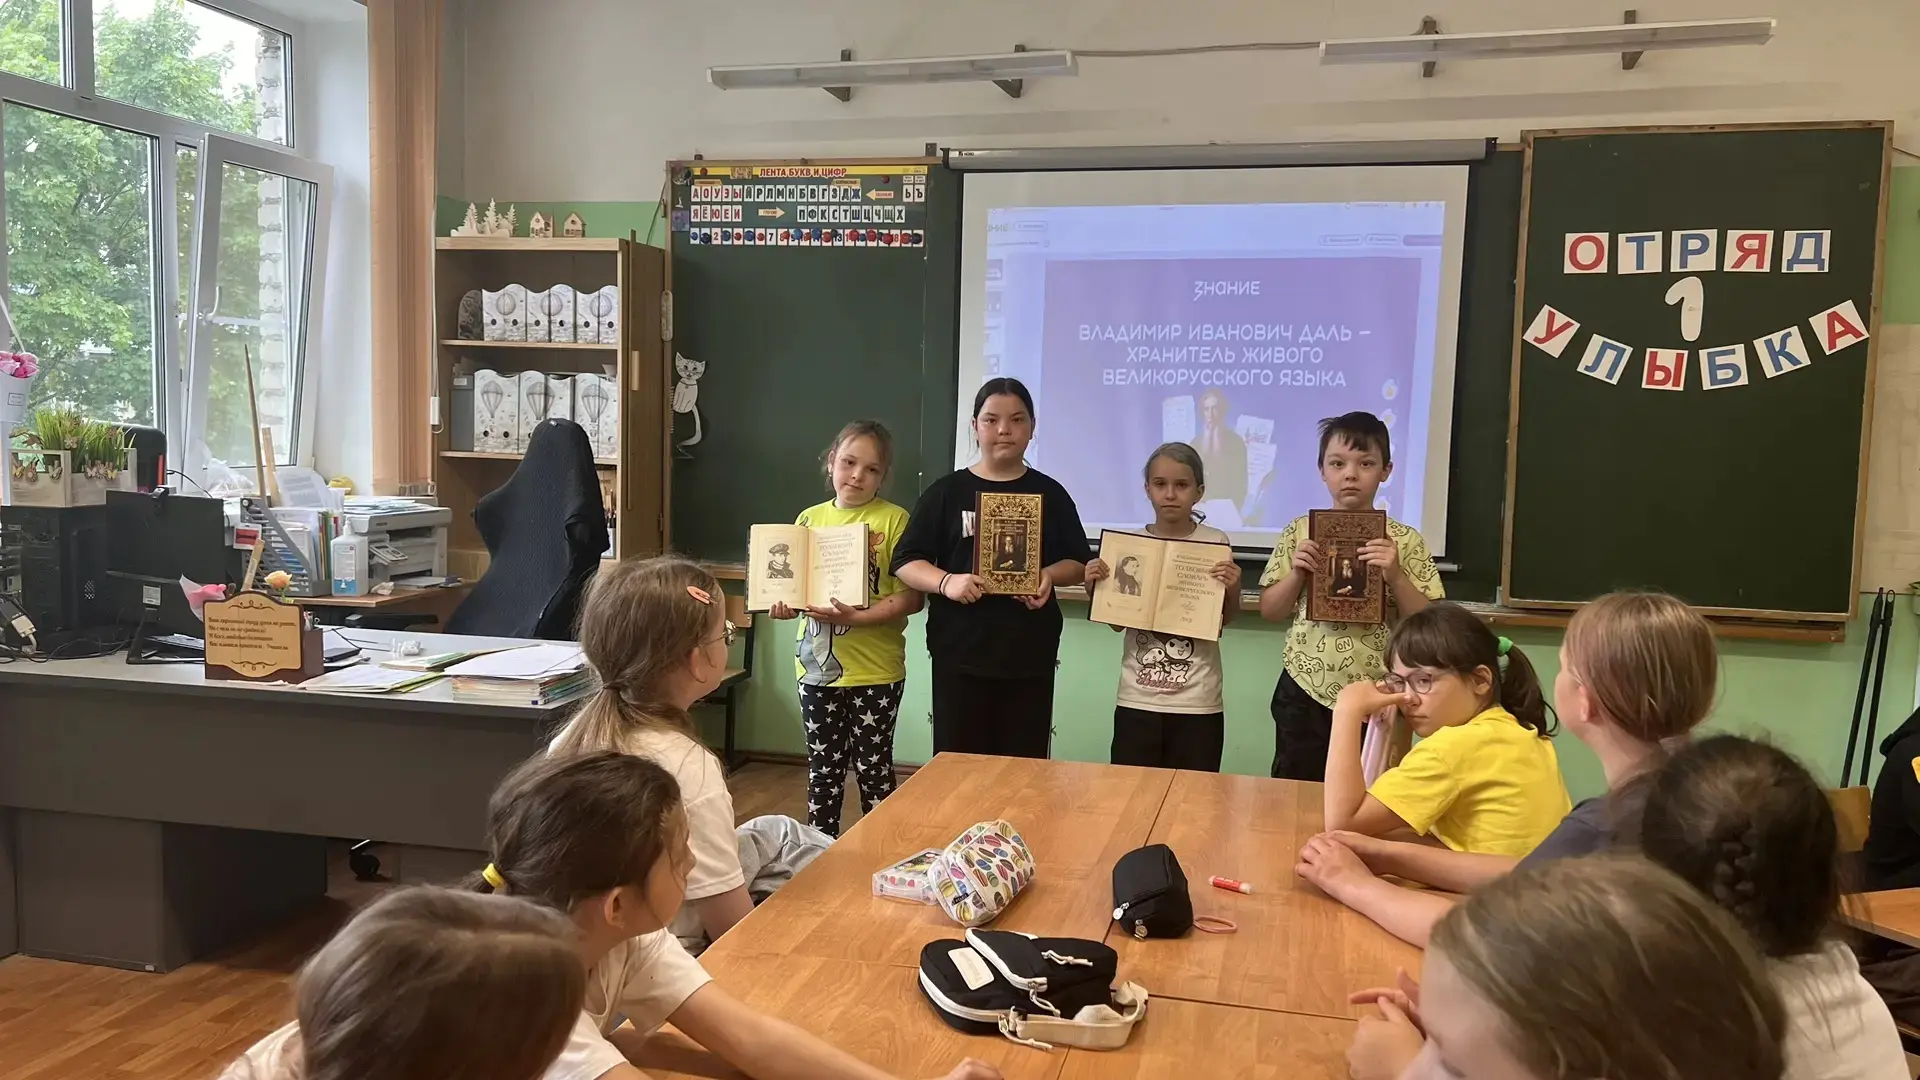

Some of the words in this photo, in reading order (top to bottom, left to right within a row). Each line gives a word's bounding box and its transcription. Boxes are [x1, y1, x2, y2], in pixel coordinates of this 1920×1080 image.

[760, 168, 786, 176] ЛЕНТА
[789, 168, 811, 176] БУКВ
[814, 168, 819, 176] И
[822, 168, 847, 178] ЦИФР
[714, 232, 719, 241] 2
[768, 233, 774, 242] 7
[1568, 233, 1825, 271] ОТРЯД
[1664, 276, 1704, 342] 1
[1079, 324, 1181, 343] ВЛАДИМИР
[1188, 324, 1293, 341] ИВАНОВИЧ
[1298, 324, 1352, 343] ДАЛЬ
[1126, 346, 1236, 363] ХРАНИТЕЛЬ
[1241, 346, 1324, 364] ЖИВОГО
[1532, 310, 1865, 387] УЛЫБКА
[1102, 368, 1274, 386] ВЕЛИКОРУССКОГО
[1279, 369, 1347, 387] ЯЗЫКА
